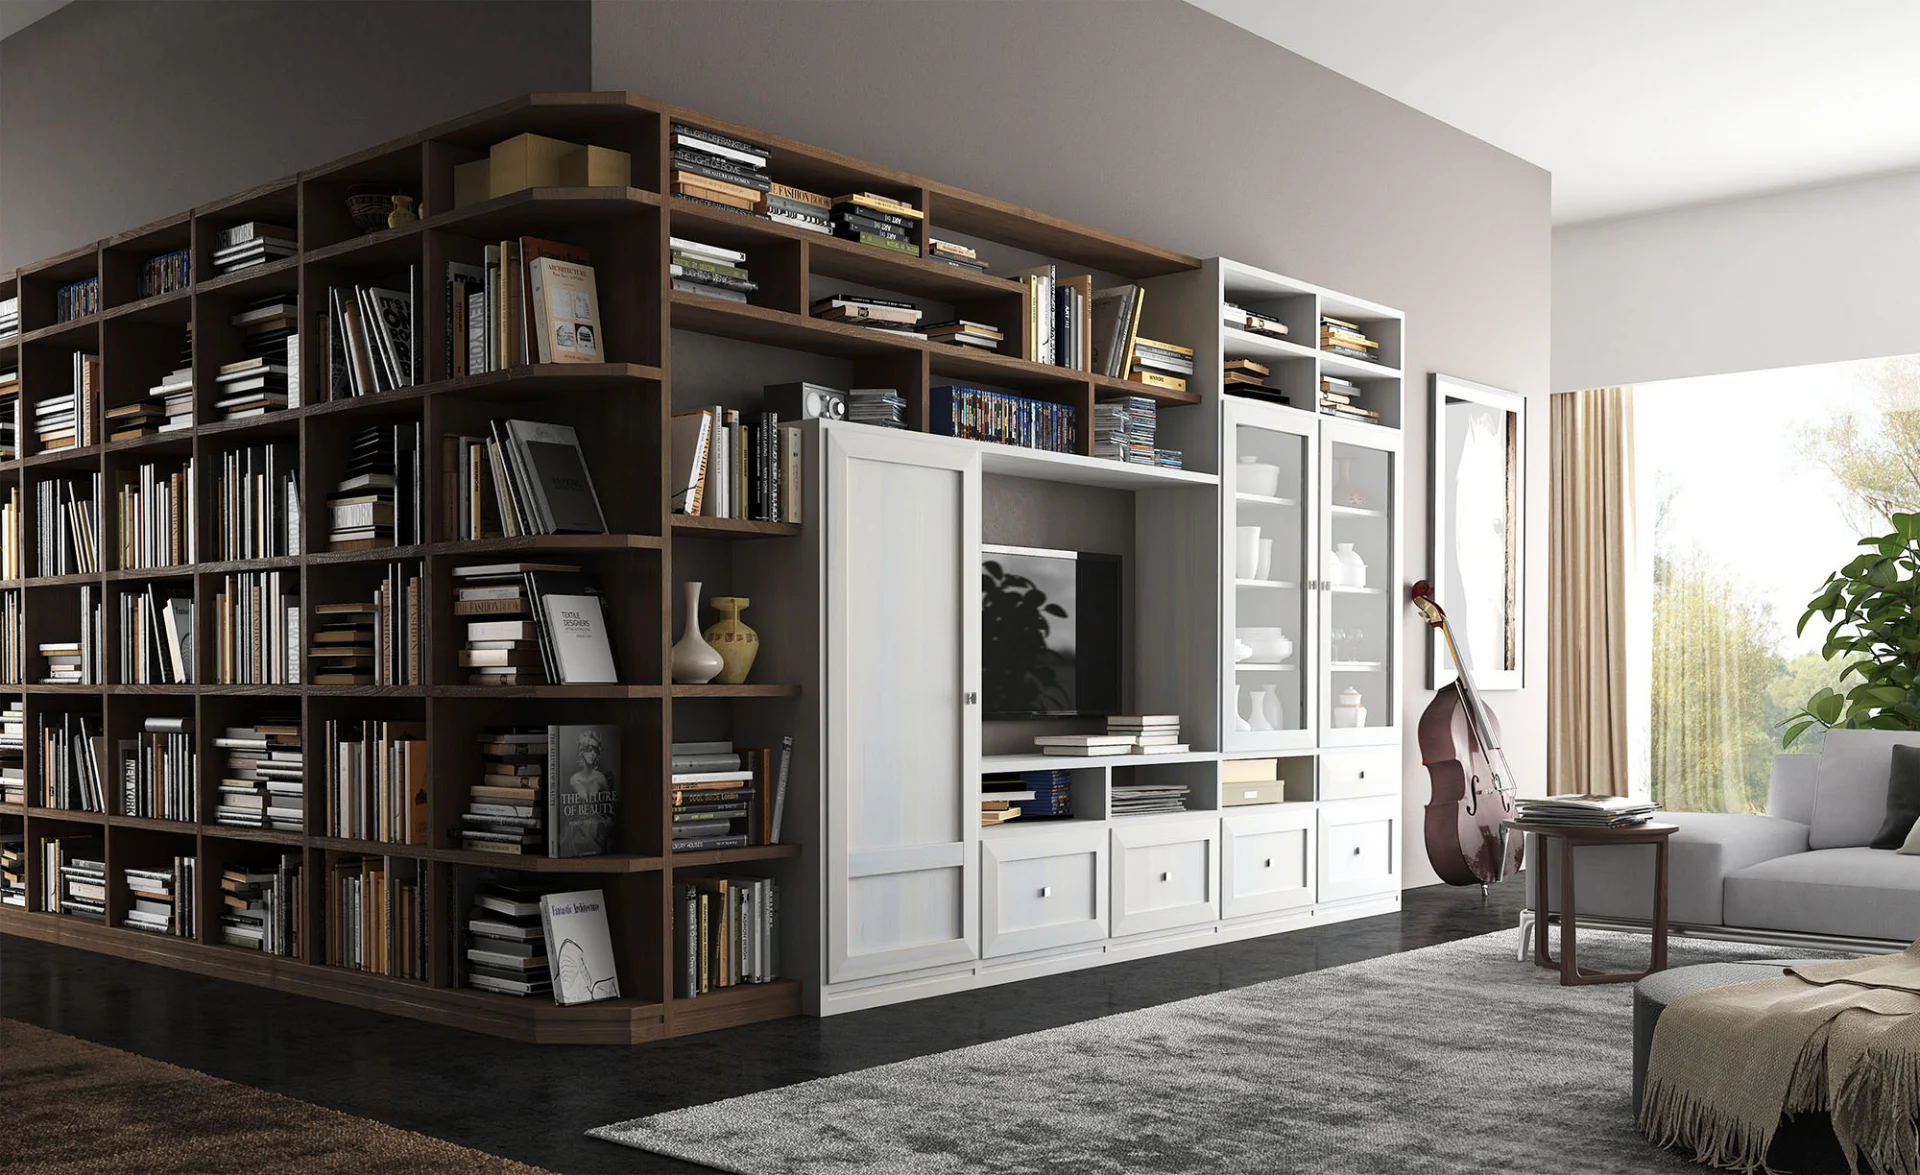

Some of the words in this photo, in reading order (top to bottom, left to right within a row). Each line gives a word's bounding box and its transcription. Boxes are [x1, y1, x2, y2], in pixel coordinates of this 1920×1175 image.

[677, 150, 691, 161] THE
[778, 185, 810, 202] FASHION
[810, 193, 831, 208] BOOK
[470, 294, 484, 329] NEW
[350, 503, 372, 526] YORK
[469, 601, 499, 614] FASHION
[561, 611, 580, 619] TEXTILE
[289, 608, 300, 640] NEW
[563, 619, 590, 627] DESIGNERS
[289, 643, 300, 682] YORK
[126, 759, 136, 784] NEW
[126, 787, 136, 815] YORK
[561, 793, 580, 804] THE
[582, 790, 618, 803] ALLURE
[563, 805, 577, 817] OF
[578, 803, 614, 816] BEAUTY
[552, 904, 572, 917] Fantastic
[573, 902, 600, 914] Architecture
